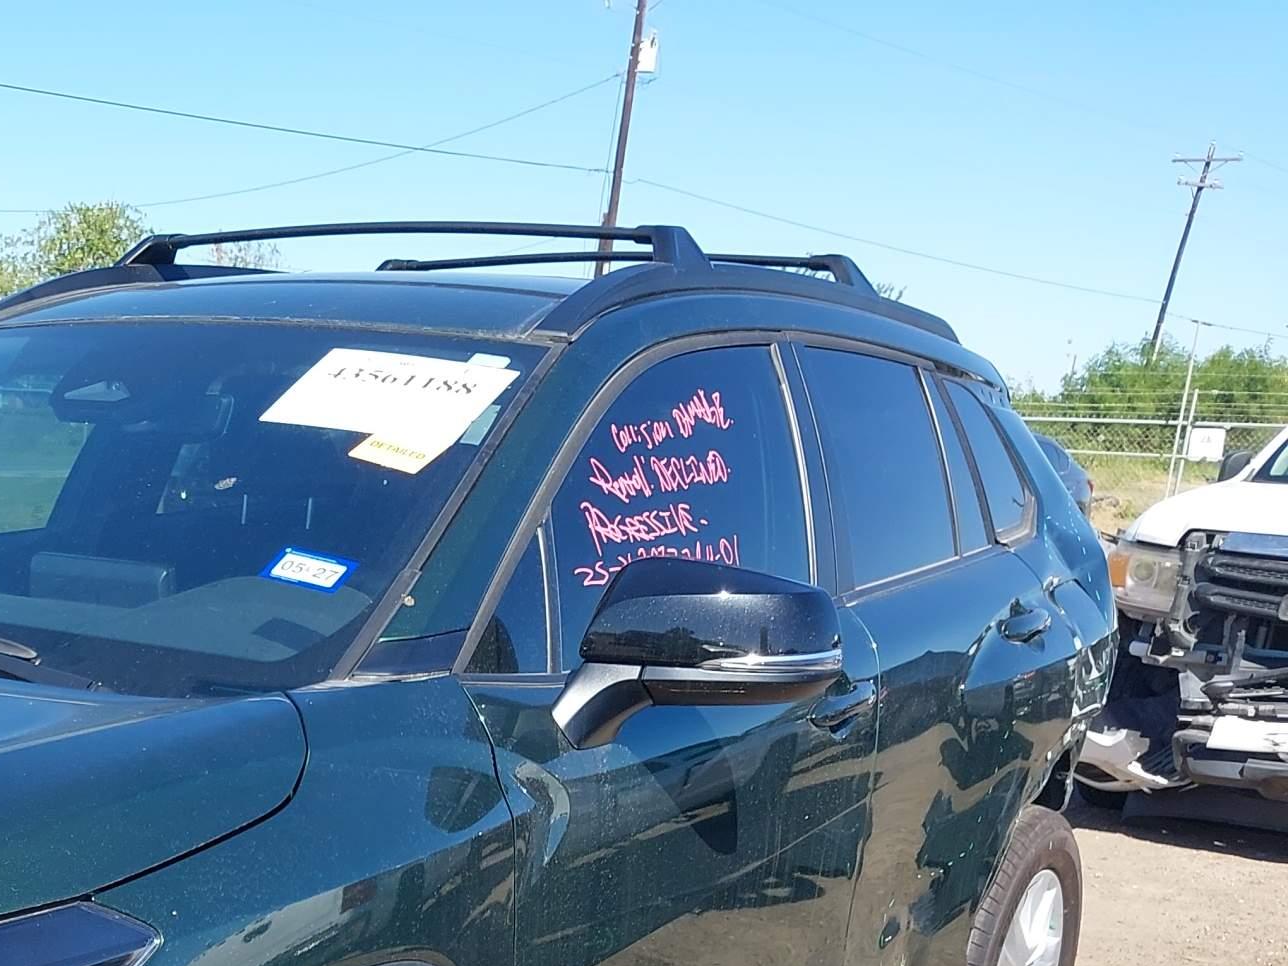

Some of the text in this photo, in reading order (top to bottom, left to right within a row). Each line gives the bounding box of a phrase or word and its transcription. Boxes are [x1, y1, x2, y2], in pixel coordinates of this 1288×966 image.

[328, 367, 477, 394] 43561188
[369, 440, 426, 460] DETAILED
[280, 560, 339, 580] 05 27
